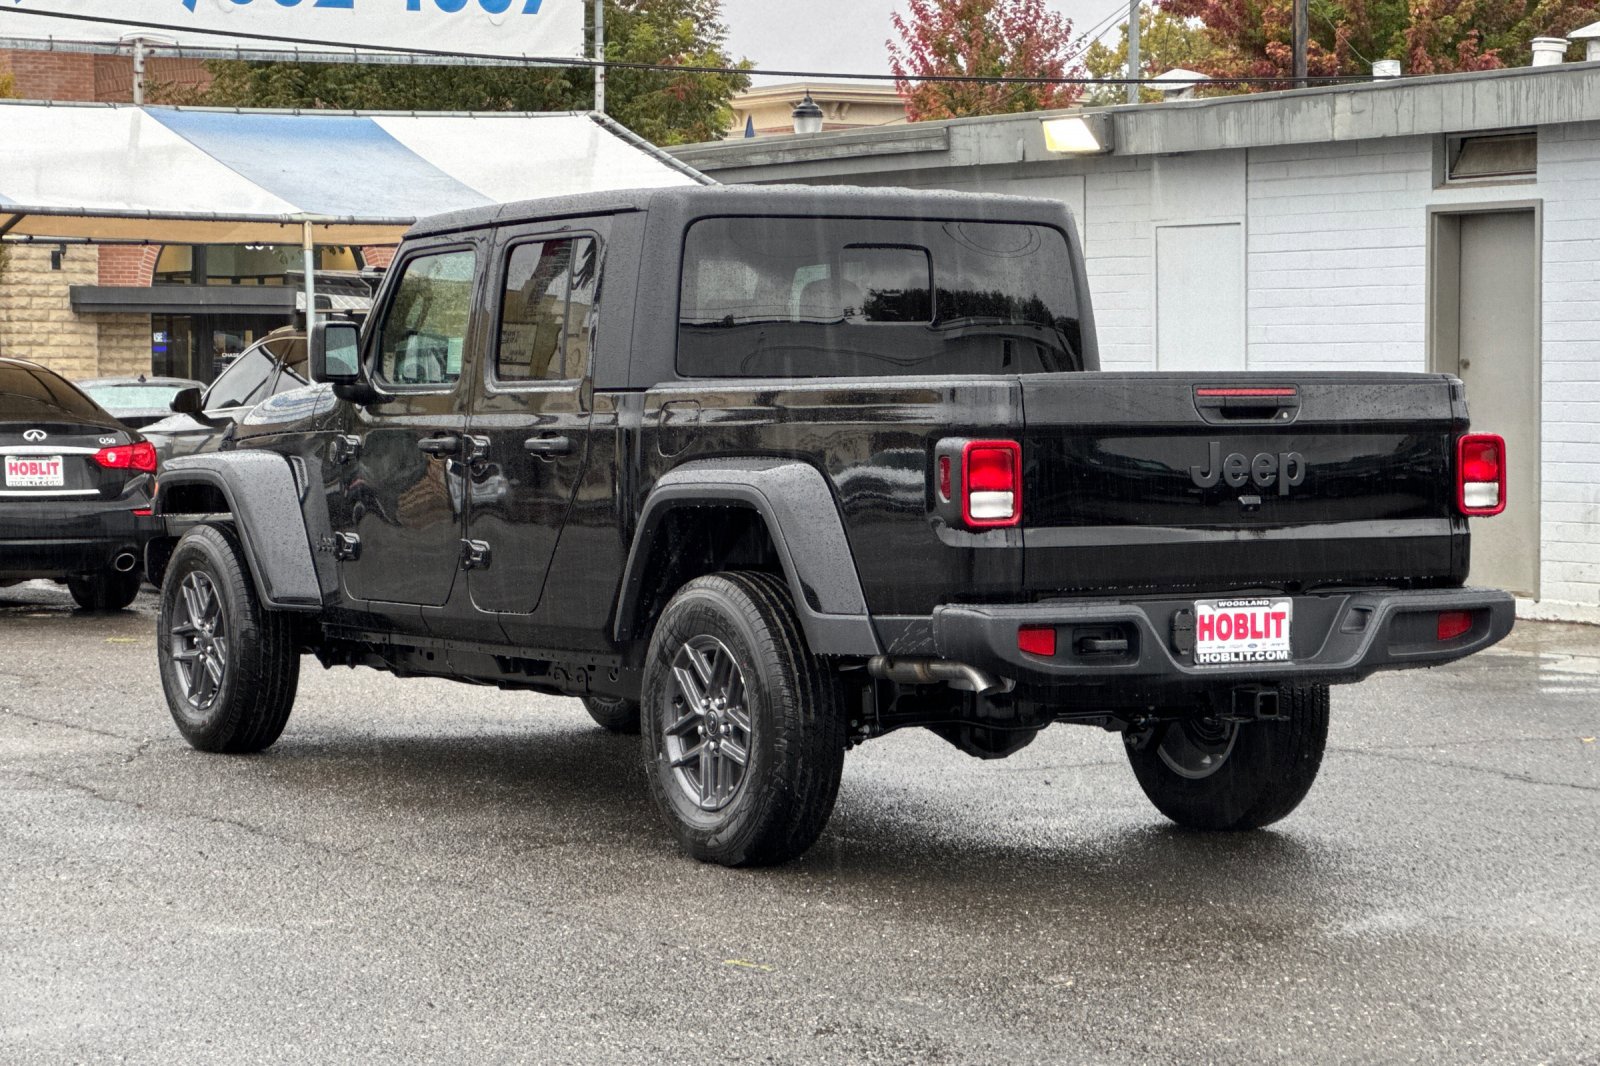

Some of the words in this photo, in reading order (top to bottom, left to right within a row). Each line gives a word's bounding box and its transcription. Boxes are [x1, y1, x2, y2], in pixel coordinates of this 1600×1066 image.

[9, 462, 59, 475] HOBLIT
[1189, 441, 1306, 496] Jeep
[1198, 611, 1287, 641] HOBLIT
[1200, 650, 1288, 663] HOBLIT.COM
